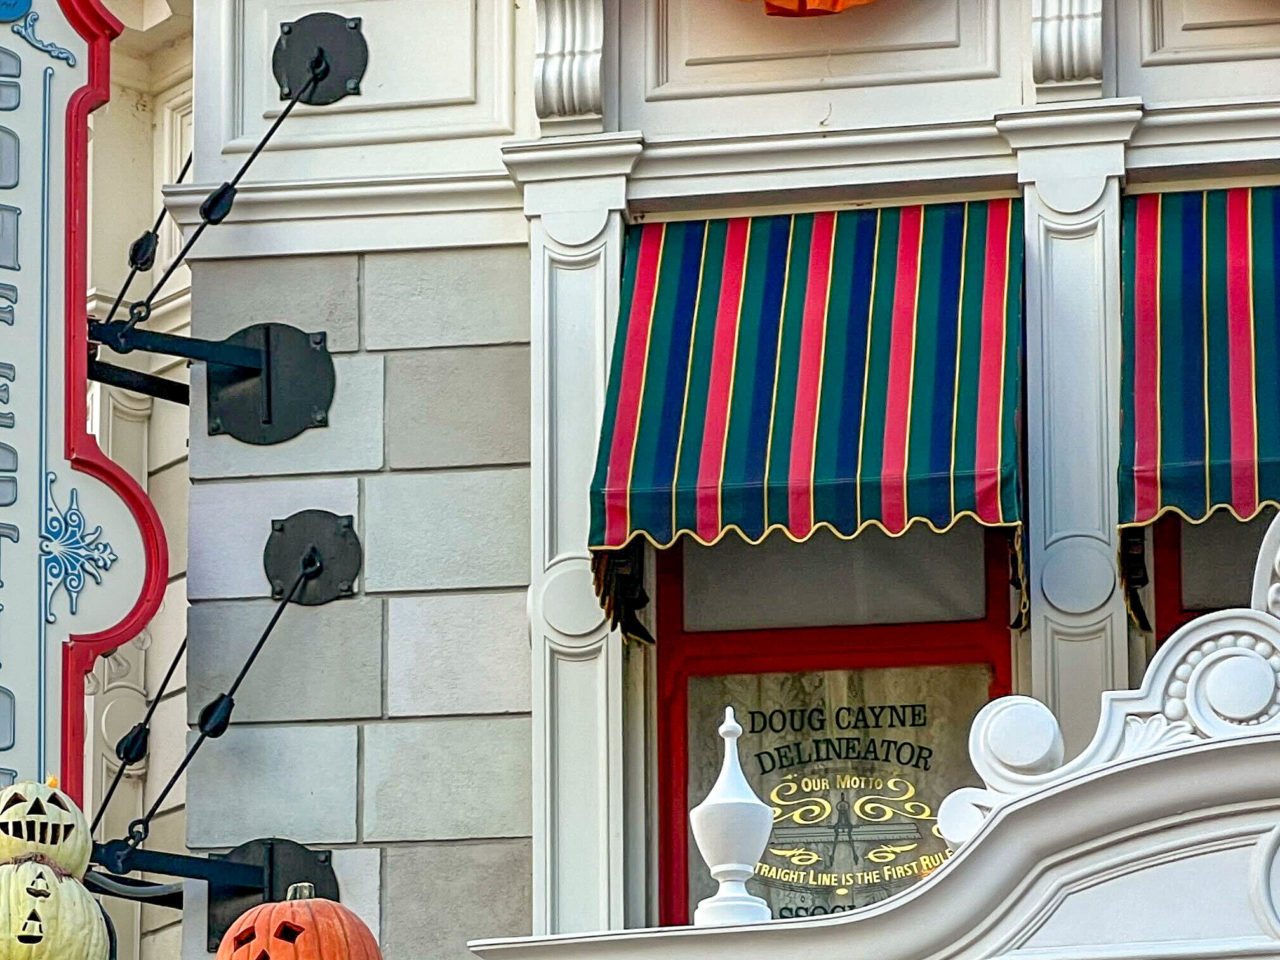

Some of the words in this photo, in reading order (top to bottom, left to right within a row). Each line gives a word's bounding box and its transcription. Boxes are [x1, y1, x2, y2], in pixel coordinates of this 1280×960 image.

[748, 708, 827, 734] DOUG
[835, 704, 927, 730] CAYNE
[754, 737, 933, 776] DELINEATOR
[754, 862, 807, 884] TRAIGHT
[809, 869, 838, 886] LINE
[842, 873, 854, 886] IS
[857, 872, 880, 884] THE
[883, 862, 918, 881] FIRST
